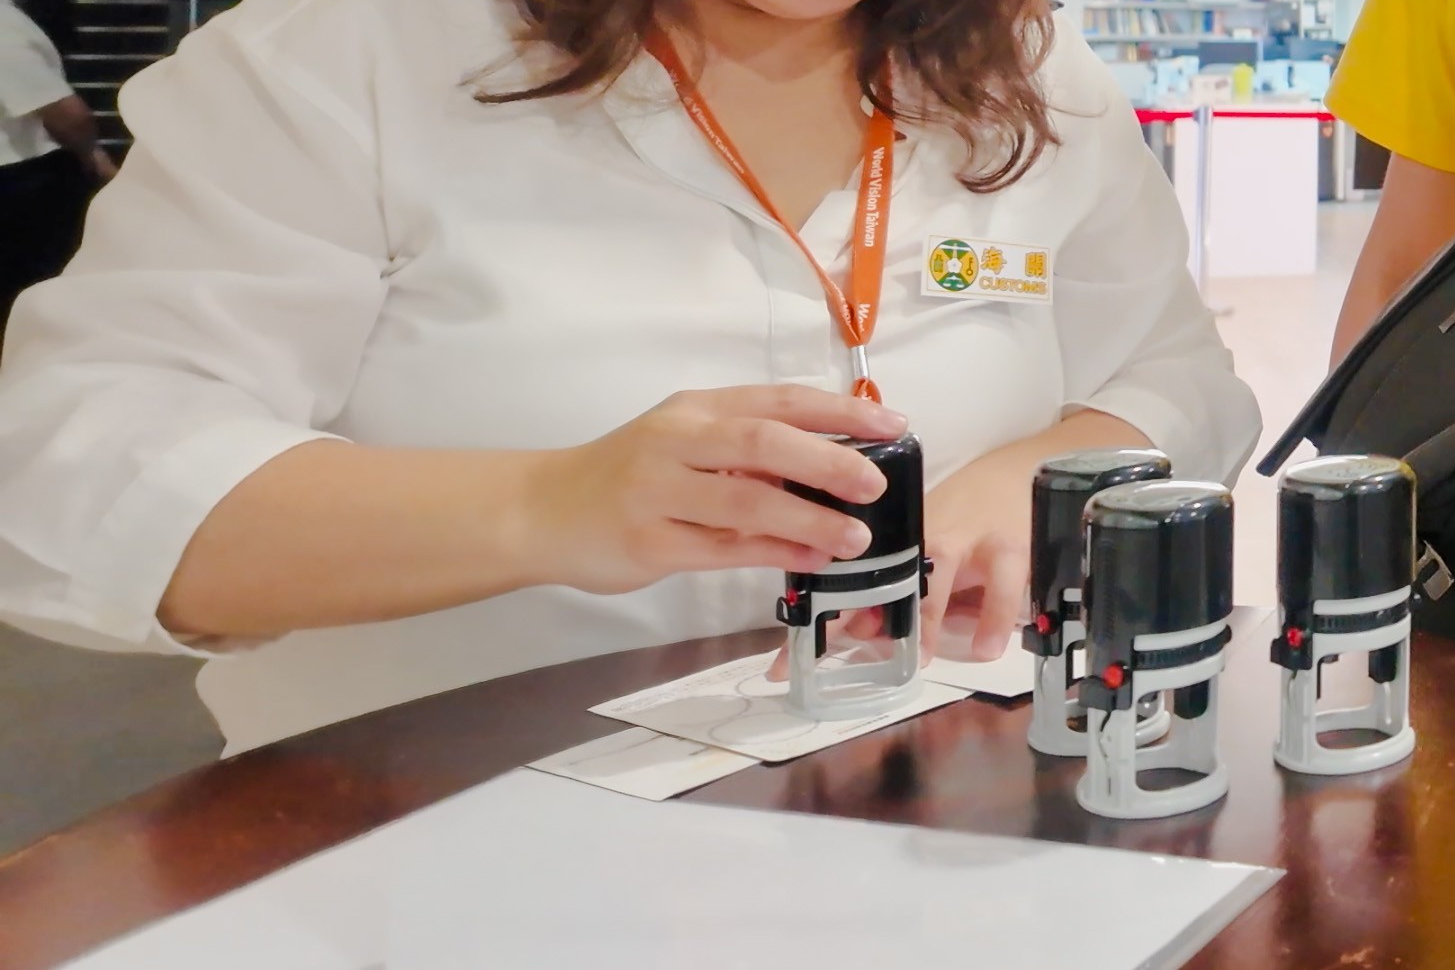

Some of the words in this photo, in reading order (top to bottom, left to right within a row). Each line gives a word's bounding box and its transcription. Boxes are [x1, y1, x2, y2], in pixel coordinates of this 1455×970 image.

[869, 146, 885, 179] World
[867, 179, 883, 211] Vision
[864, 211, 880, 248] Taiwan
[979, 276, 1048, 295] CUSTOMS
